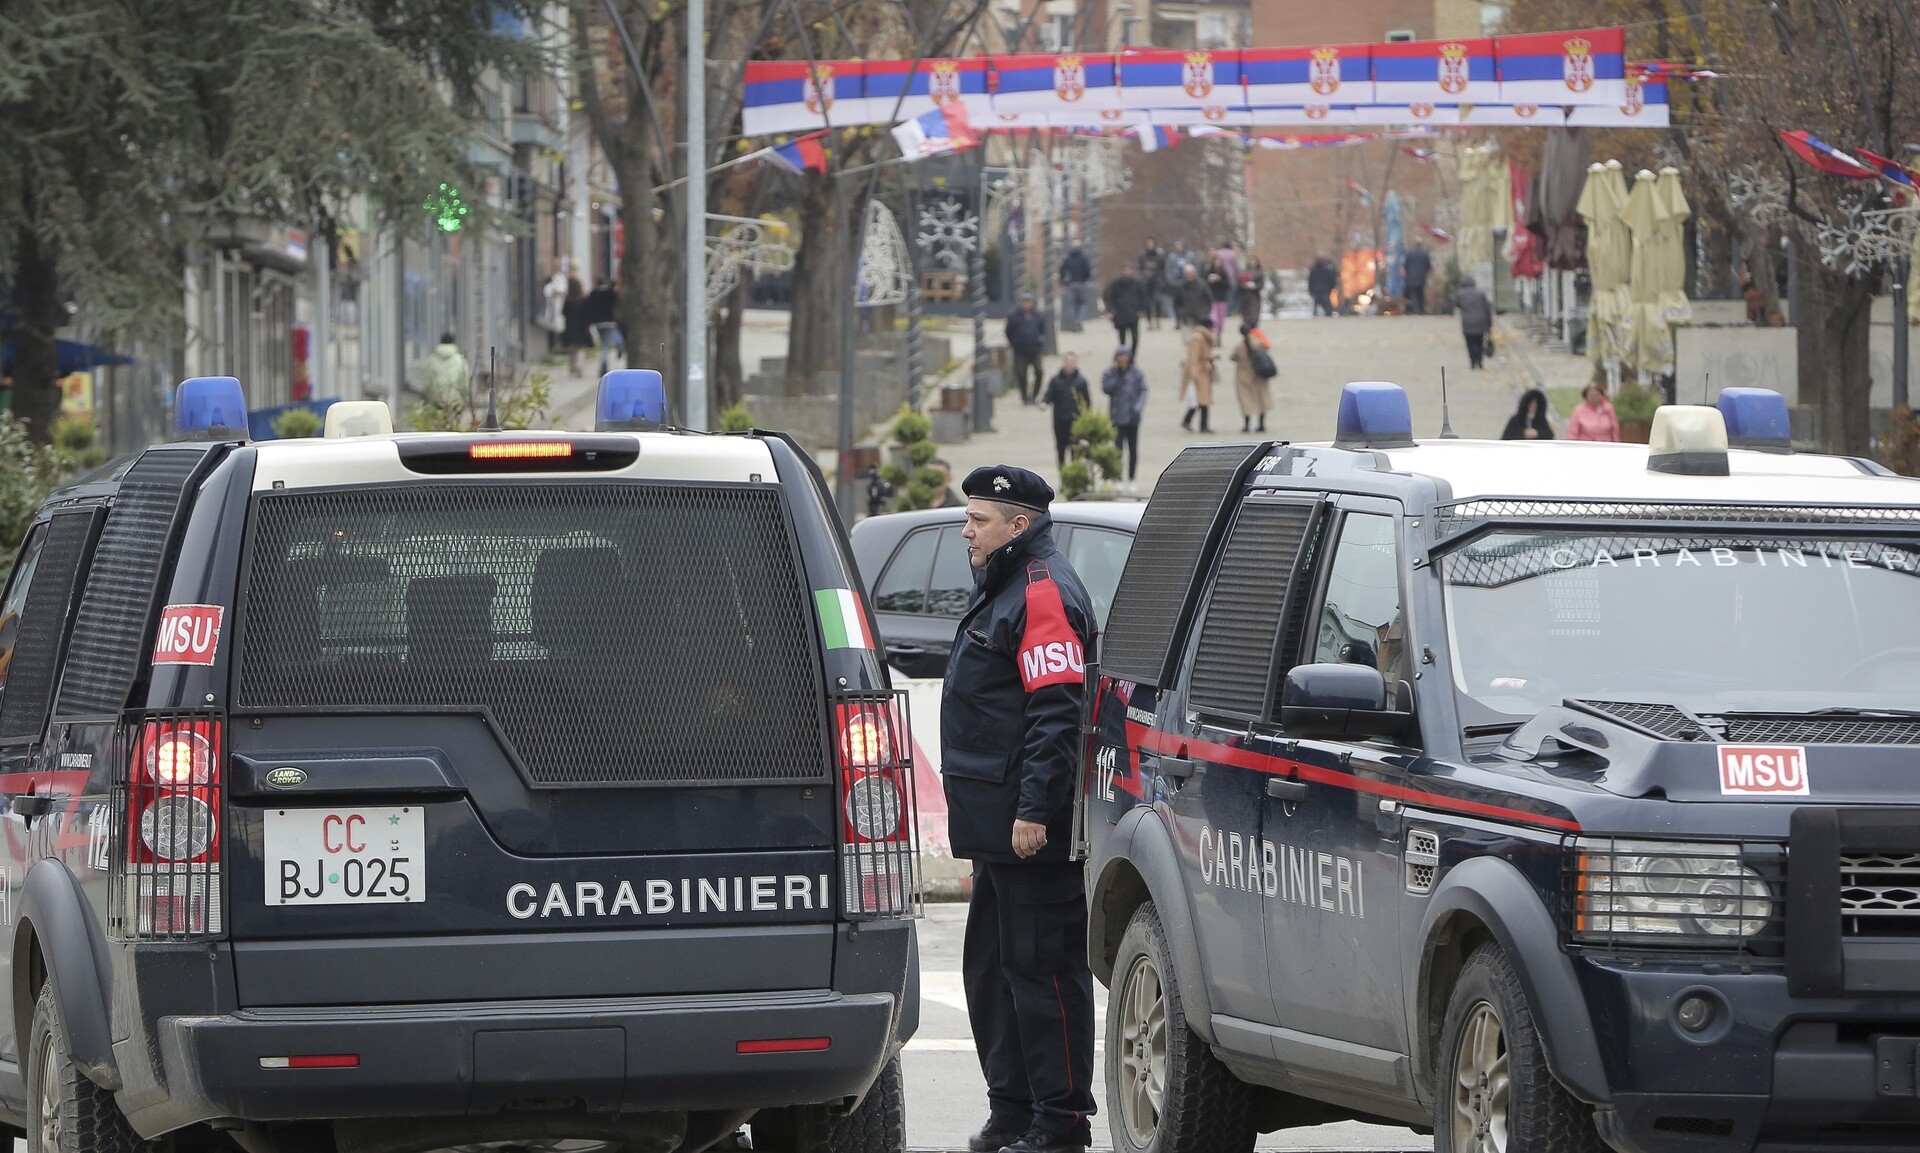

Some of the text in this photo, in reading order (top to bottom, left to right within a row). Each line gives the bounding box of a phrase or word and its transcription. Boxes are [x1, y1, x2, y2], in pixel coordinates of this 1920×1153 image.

[157, 614, 213, 654] MSU
[1022, 641, 1085, 683] MSU
[1096, 745, 1115, 803] 112
[1727, 753, 1801, 788] MSU
[322, 813, 366, 854] CC
[1198, 825, 1366, 920] CARABINIERI
[505, 874, 829, 920] CARABINIERI
